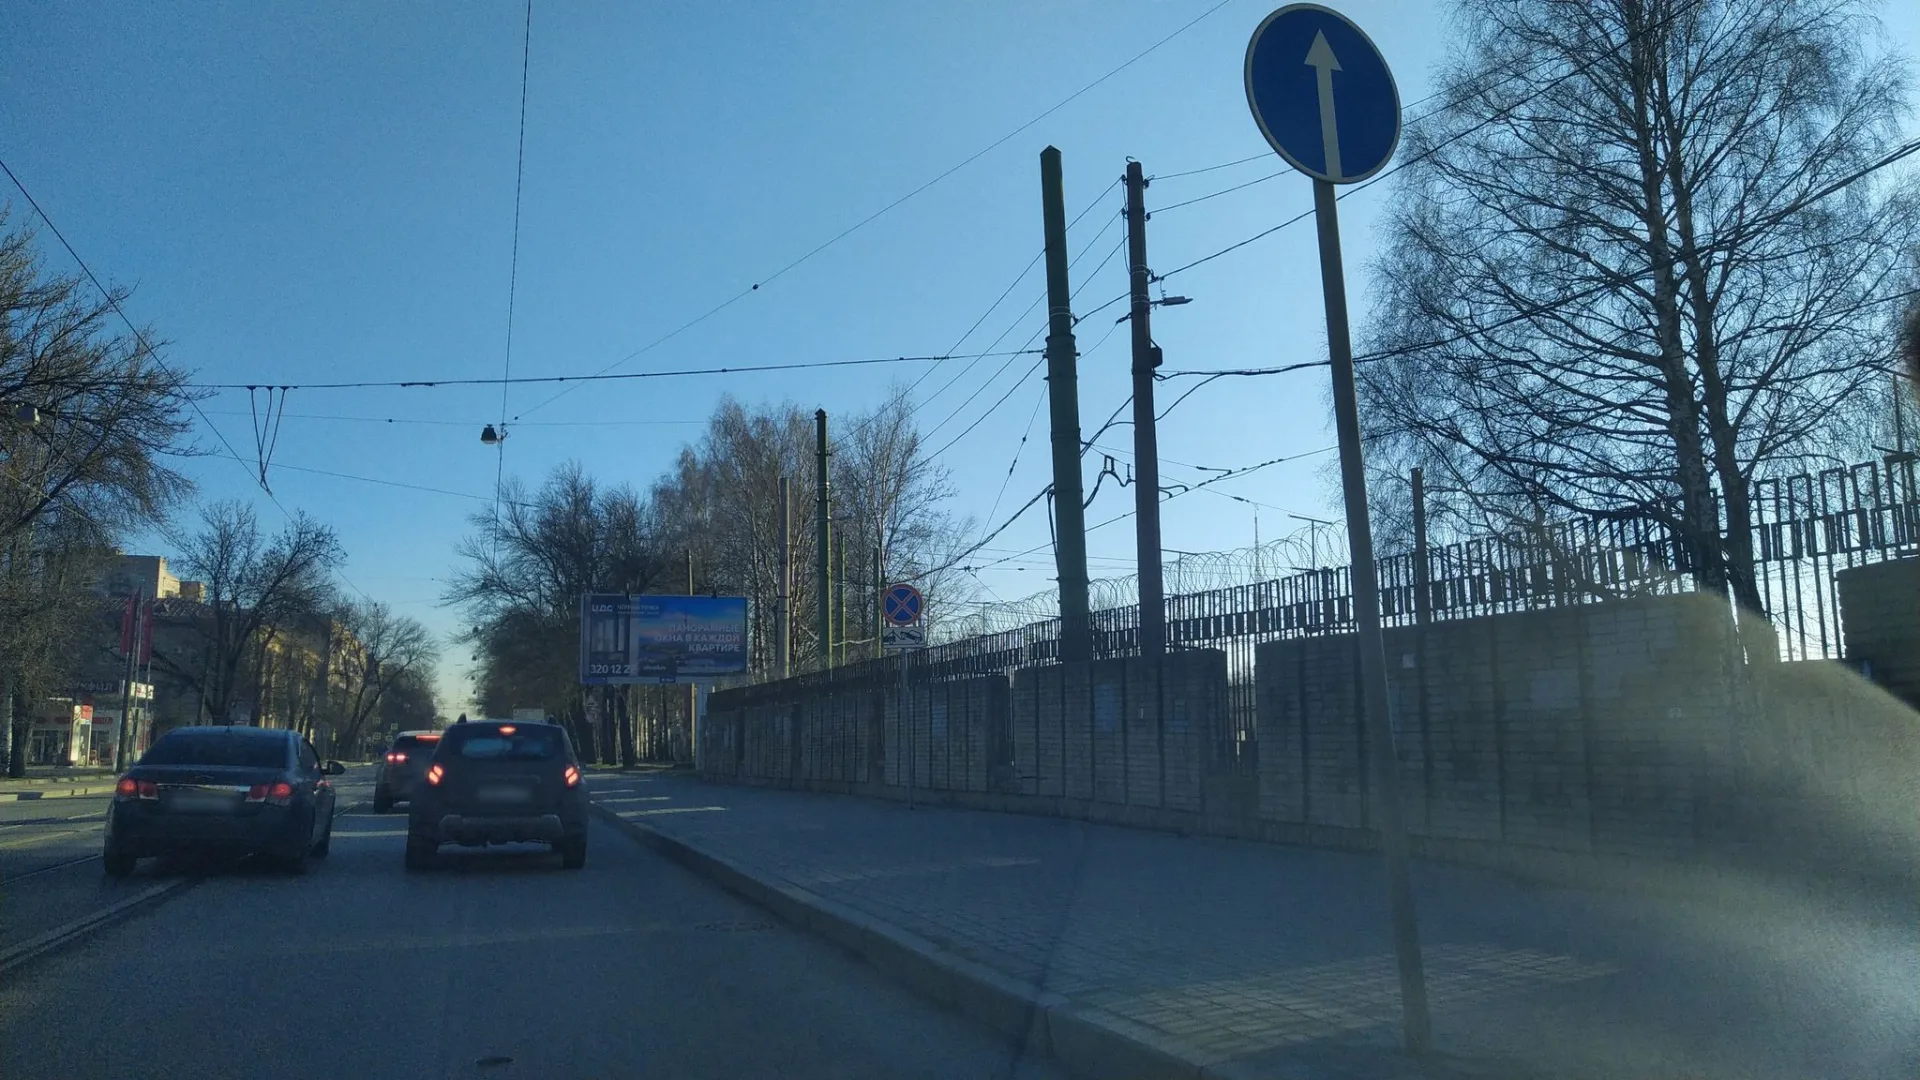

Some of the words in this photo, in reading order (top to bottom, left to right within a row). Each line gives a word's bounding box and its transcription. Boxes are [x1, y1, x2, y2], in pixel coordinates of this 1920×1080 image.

[668, 623, 741, 633] ПАНОРАМНЫЕ
[654, 634, 684, 643] ОКНА
[685, 634, 692, 642] В
[693, 632, 741, 643] КАЖДОЙ
[688, 643, 741, 653] КВАРТИРЕ
[590, 664, 609, 674] 320
[610, 664, 622, 674] 12
